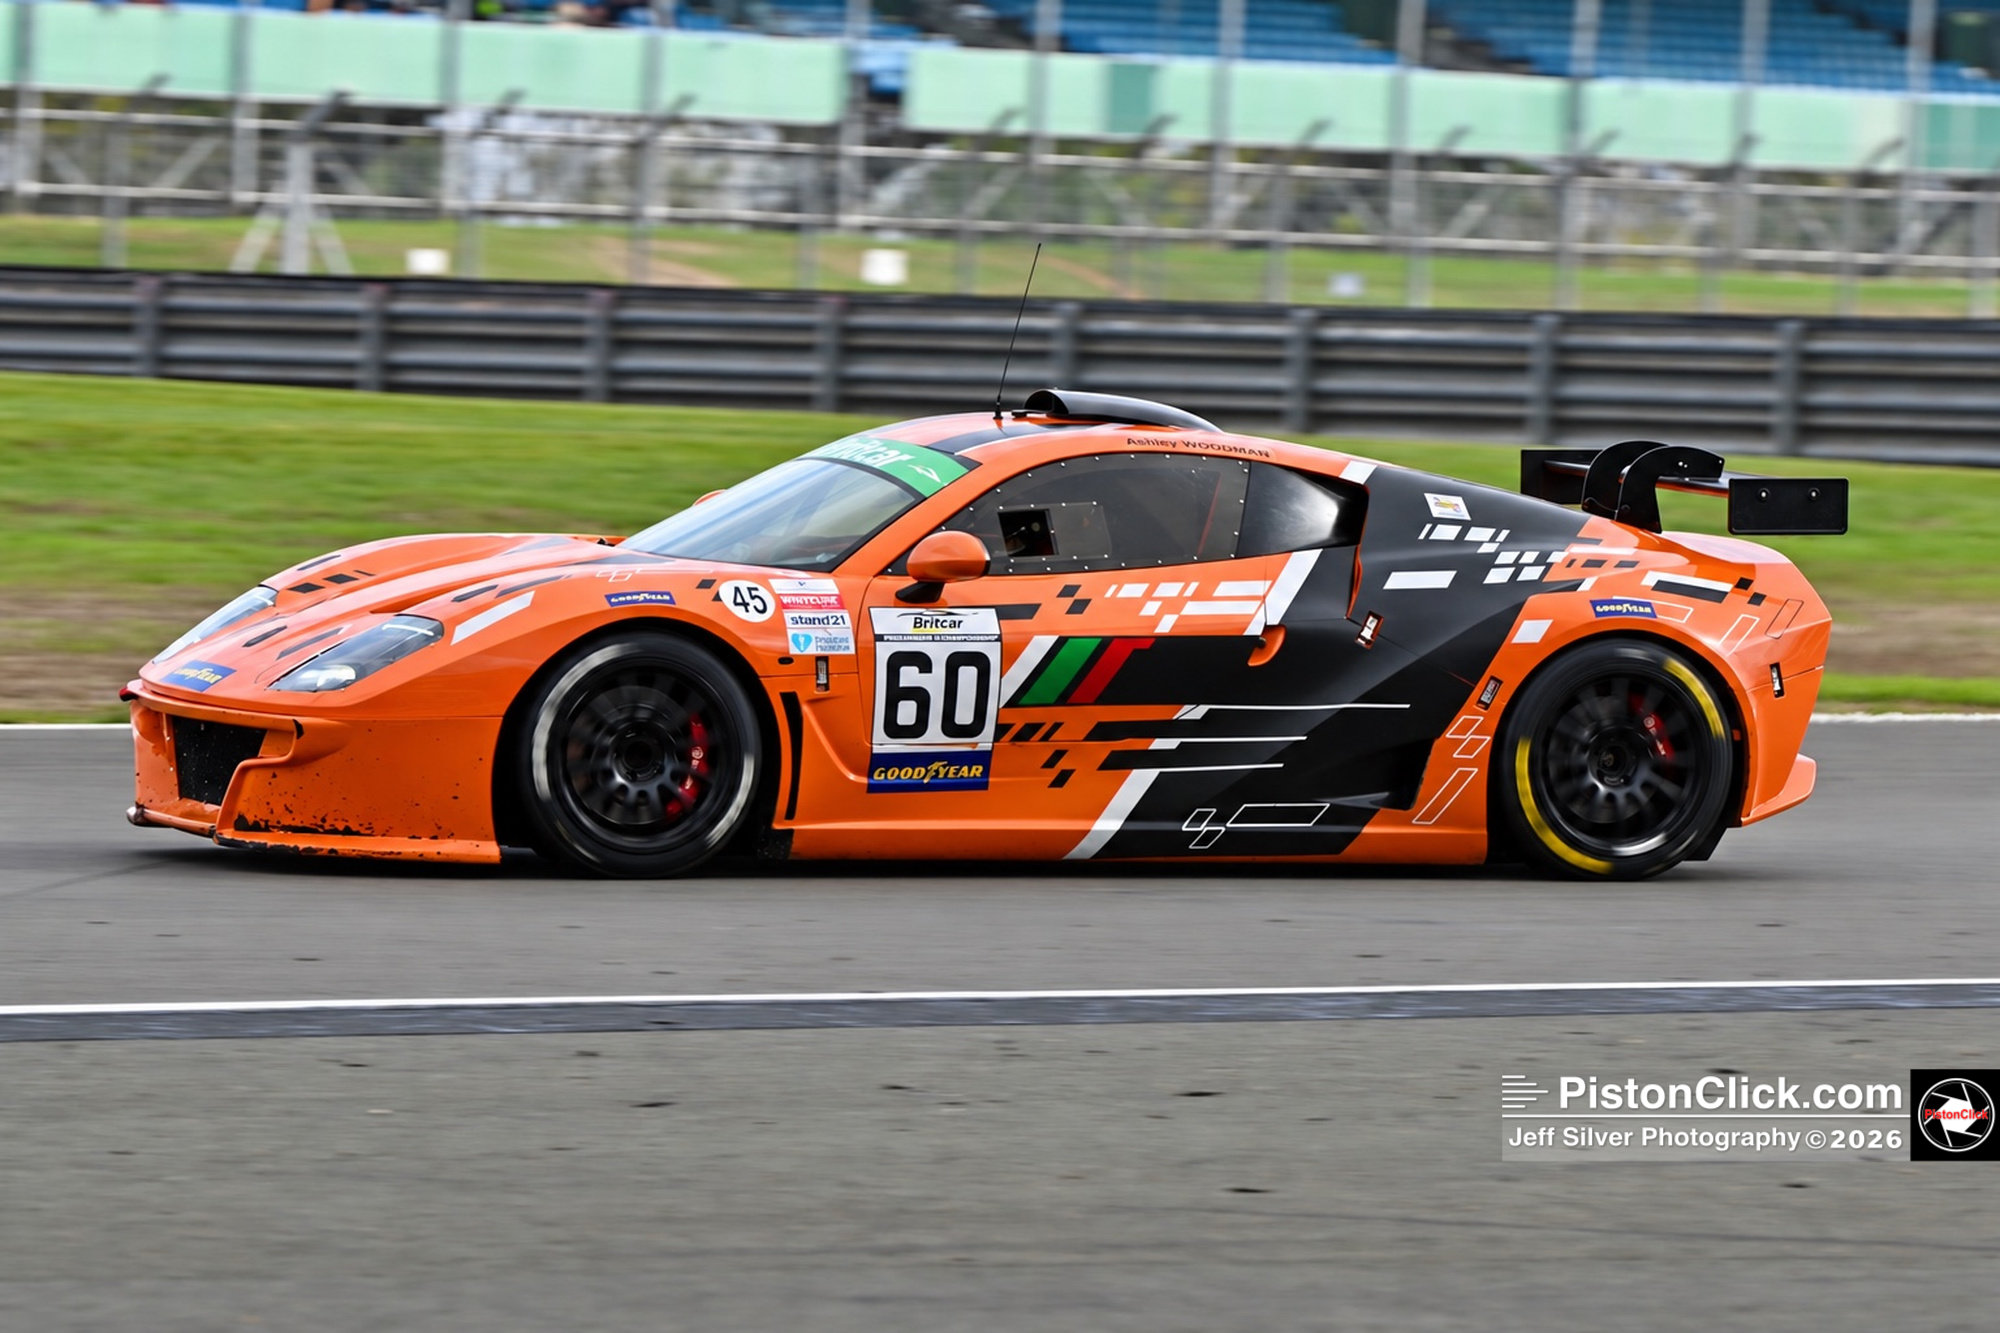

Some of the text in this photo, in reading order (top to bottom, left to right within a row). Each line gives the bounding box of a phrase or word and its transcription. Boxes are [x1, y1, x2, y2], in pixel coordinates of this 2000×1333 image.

[1126, 437, 1271, 458] Ashley WOODMAN
[731, 586, 768, 616] 45
[790, 614, 846, 626] stand21
[912, 616, 964, 630] Britcar
[883, 651, 991, 740] 60
[873, 761, 984, 784] GOODYEAR
